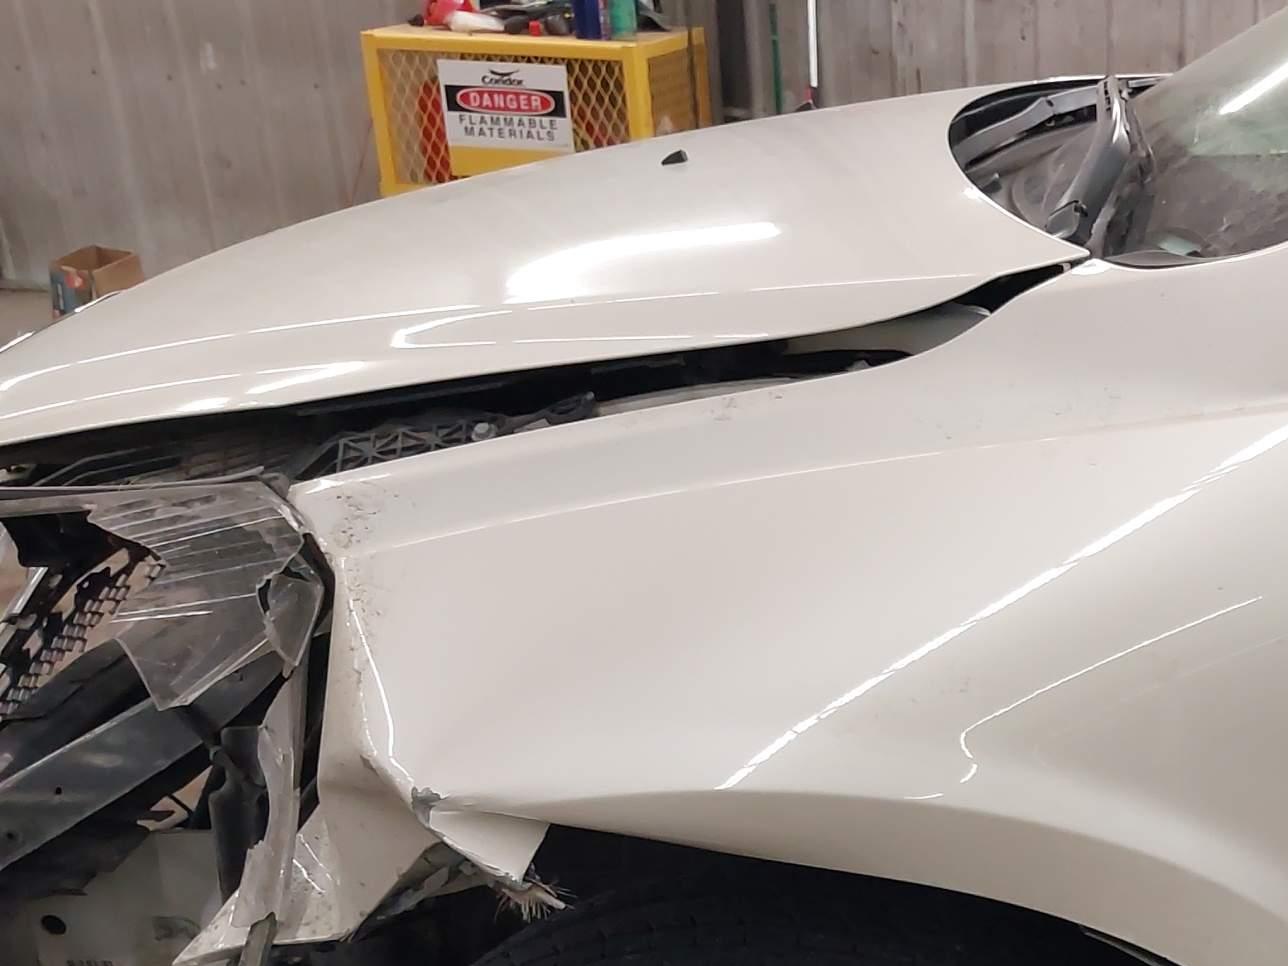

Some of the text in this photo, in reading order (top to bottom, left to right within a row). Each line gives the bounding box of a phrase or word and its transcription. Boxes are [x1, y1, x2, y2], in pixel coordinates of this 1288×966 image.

[481, 75, 524, 86] Condor
[469, 92, 541, 111] DANGER
[459, 114, 557, 130] FLAMMABLE
[464, 125, 554, 141] MATERIALS
